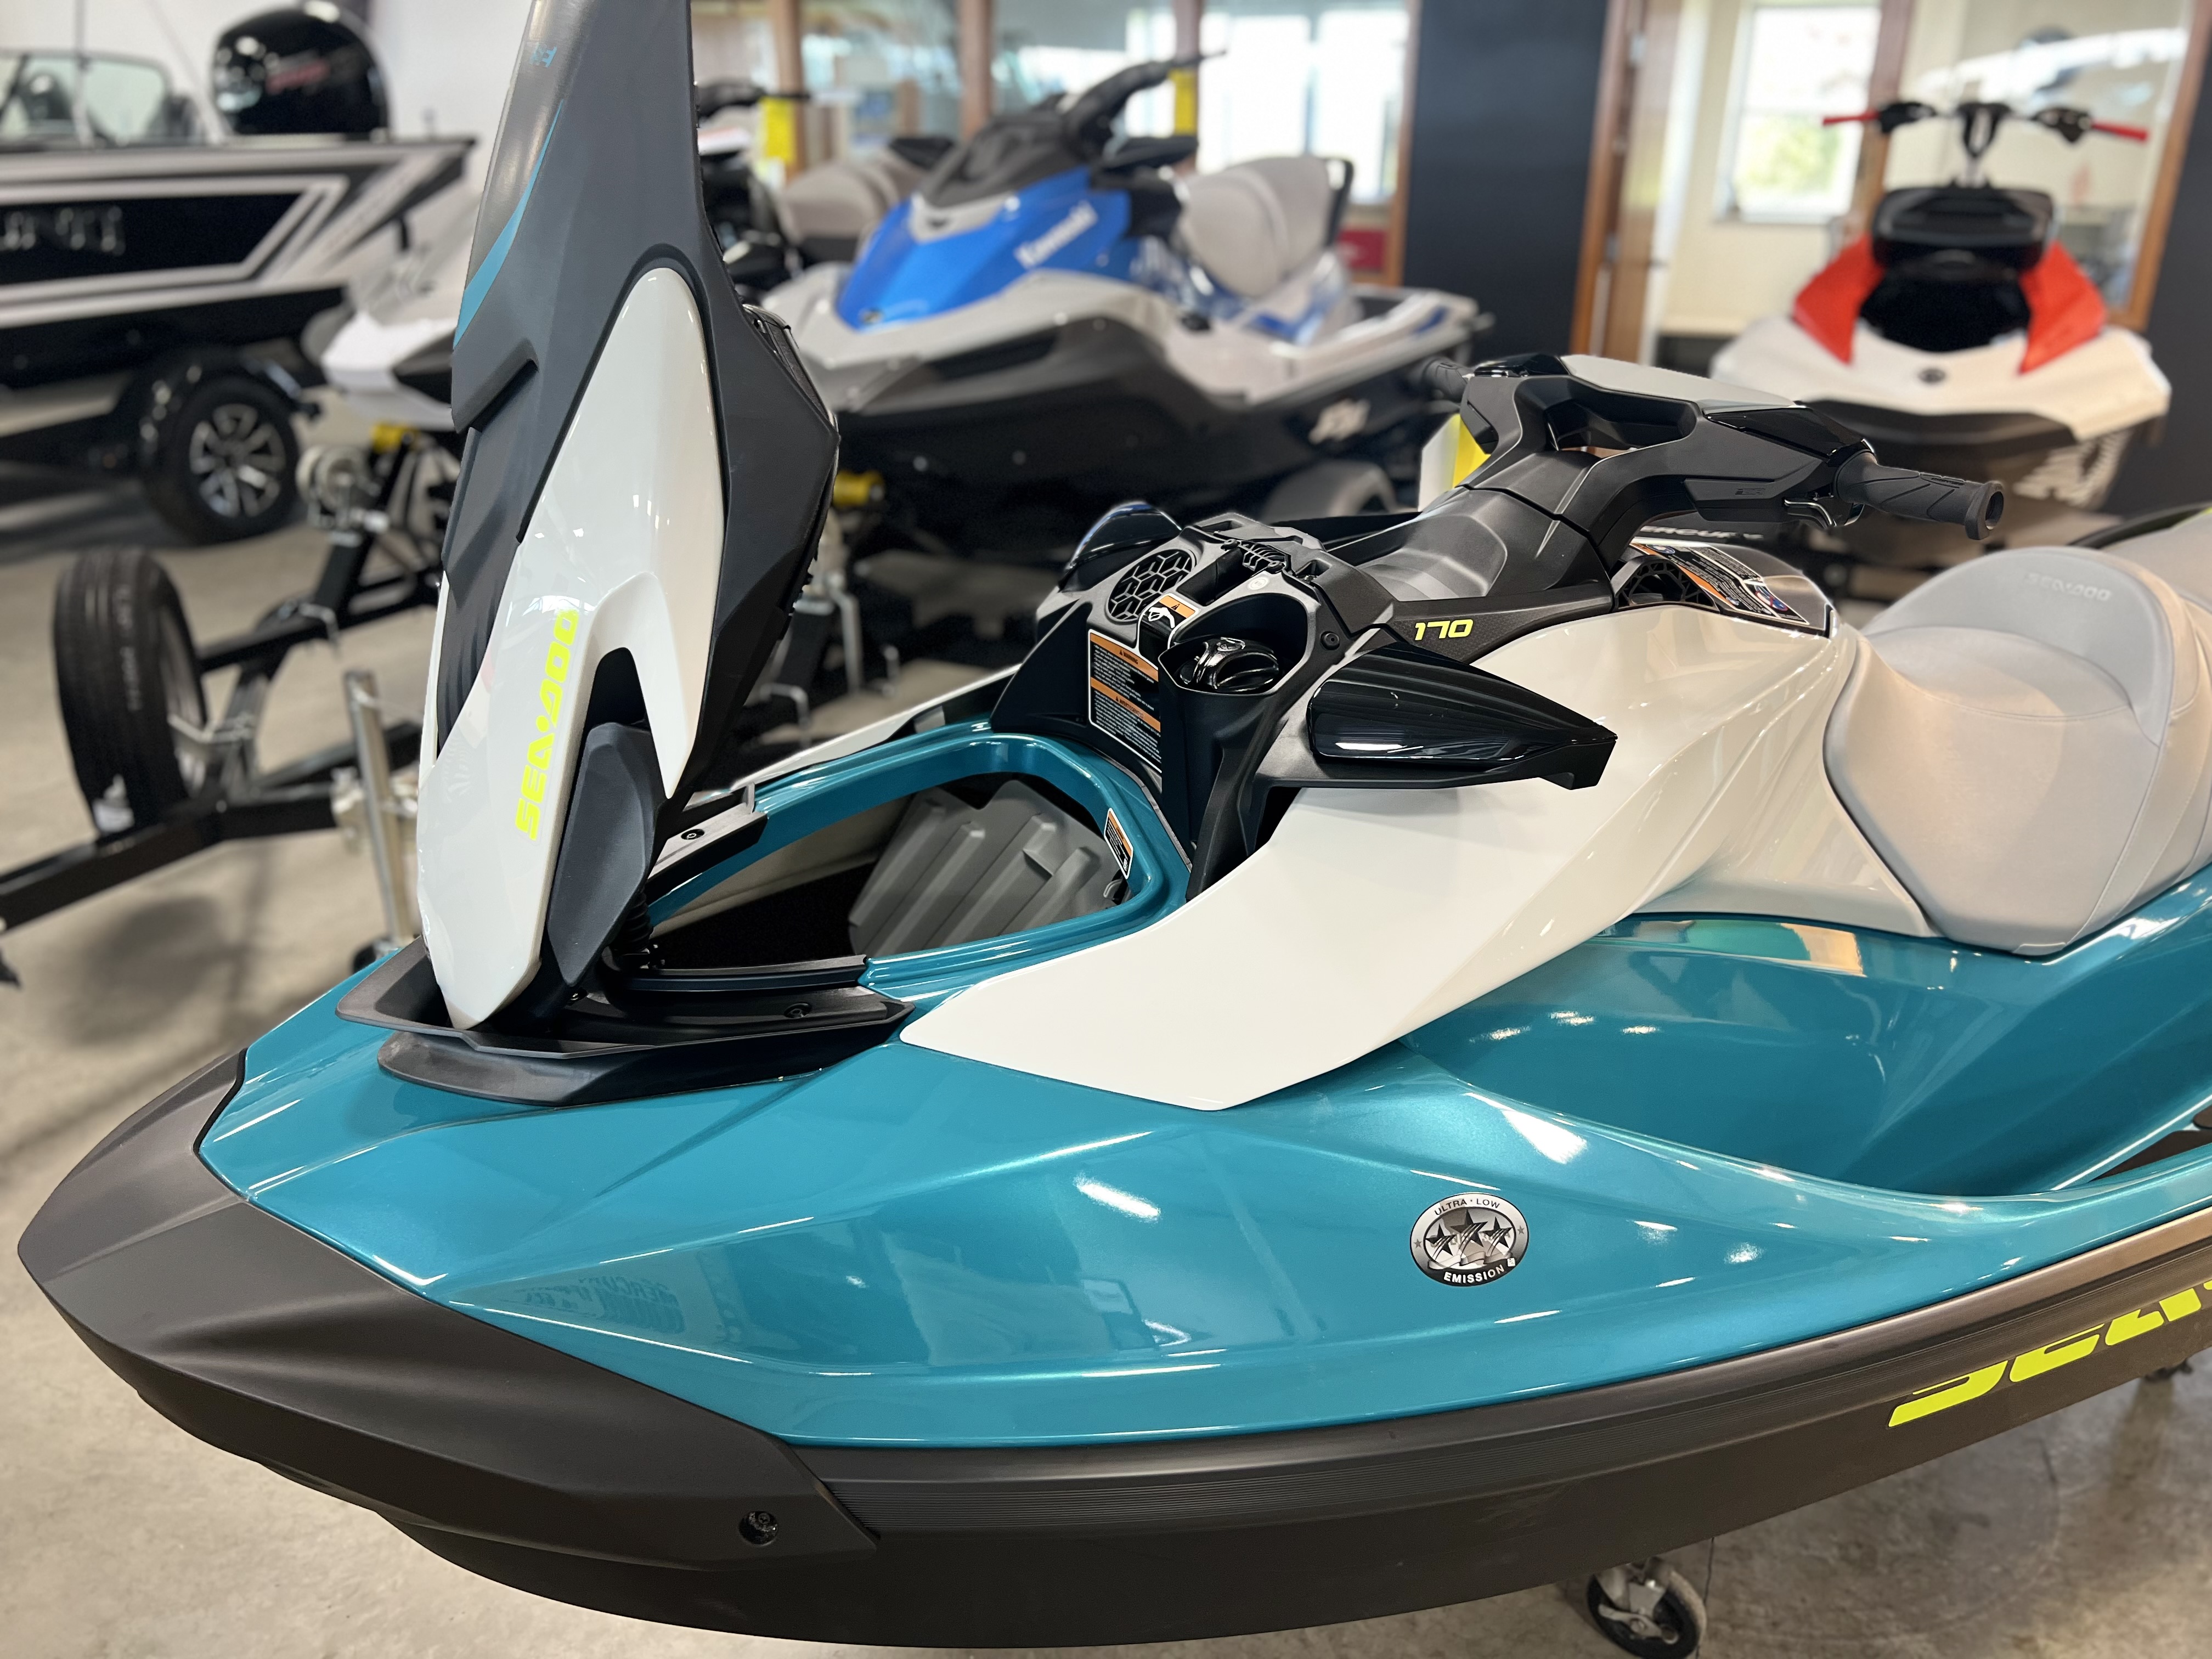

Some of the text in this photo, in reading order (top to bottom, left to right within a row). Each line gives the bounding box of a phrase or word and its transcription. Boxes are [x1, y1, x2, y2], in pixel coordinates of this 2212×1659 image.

[1415, 618, 1474, 641] 170
[1434, 1198, 1500, 1216] ULTRA LOW
[1443, 1264, 1505, 1284] EMISSION
